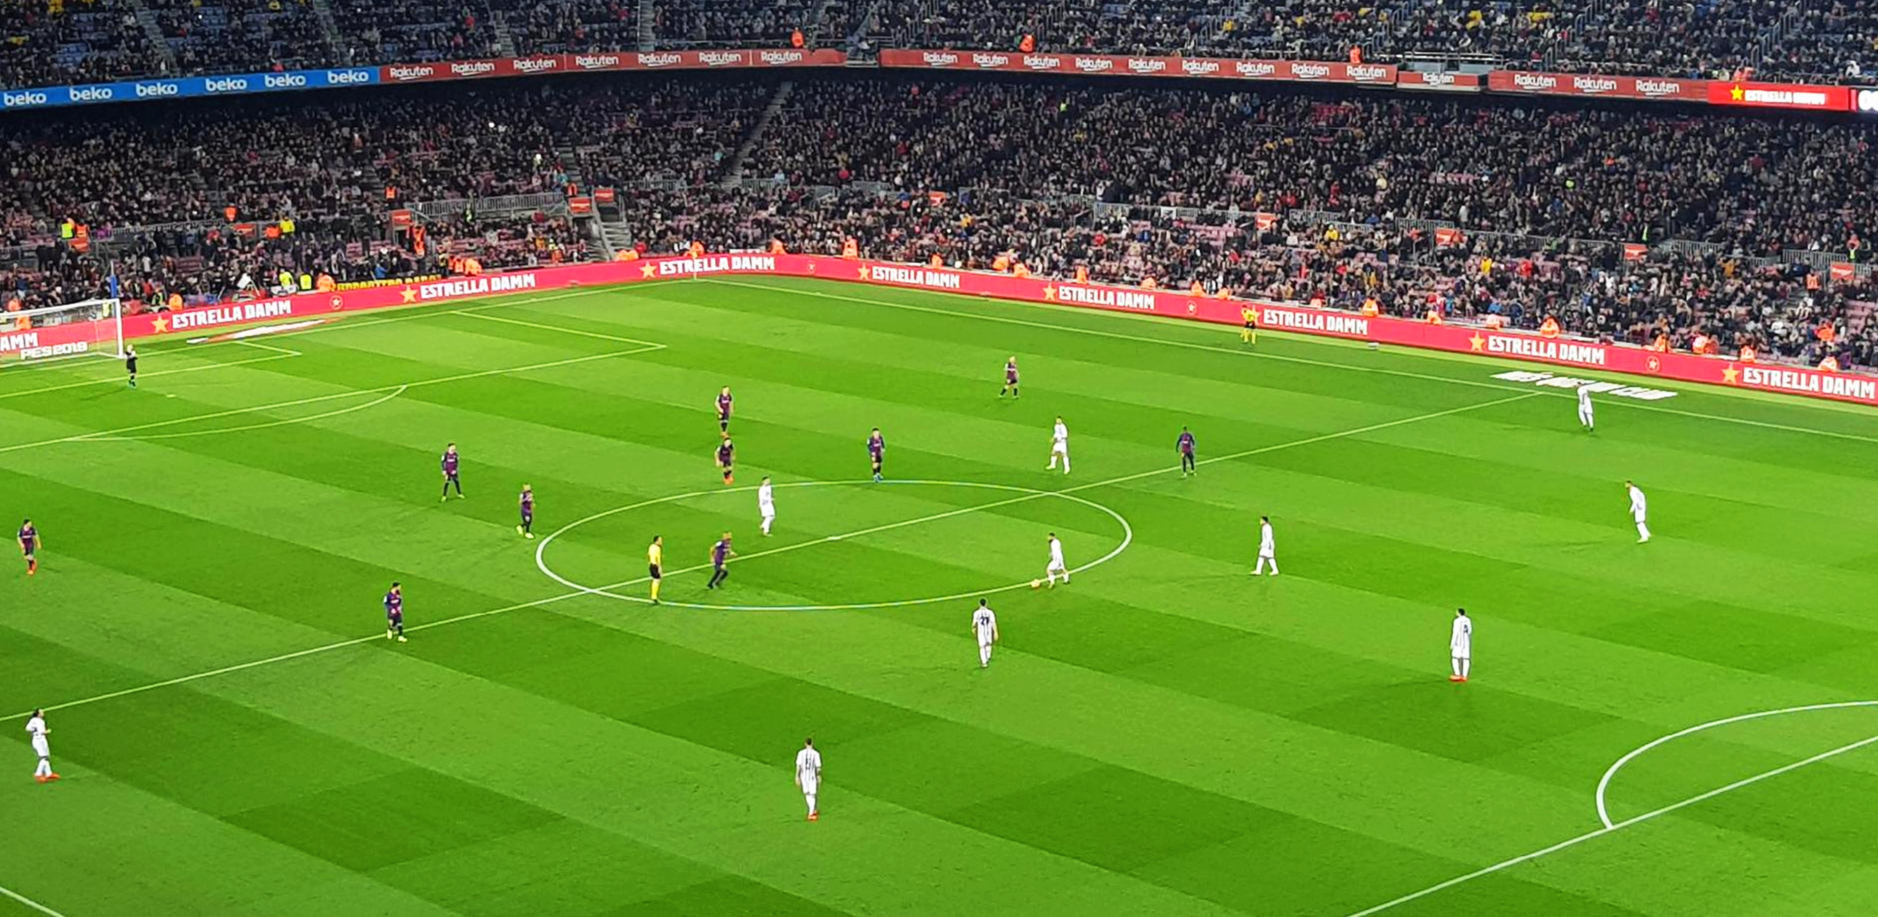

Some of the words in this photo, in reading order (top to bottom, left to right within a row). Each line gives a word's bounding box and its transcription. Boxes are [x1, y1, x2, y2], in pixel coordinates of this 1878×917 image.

[576, 55, 619, 65] Rakuten
[638, 53, 681, 64] Rakuten
[699, 52, 741, 62] Rakuten
[761, 51, 802, 61] Rakuten
[923, 52, 957, 63] Rakuten
[973, 54, 1008, 64] Rakuten
[1024, 56, 1060, 67] Rakuten
[451, 62, 495, 73] Rakuten
[513, 59, 556, 70] Rakuten
[1075, 58, 1112, 68] Rakuten
[1128, 59, 1165, 70] Rakuten
[1182, 60, 1219, 71] Rakuten
[1236, 62, 1274, 73] Rakuten
[390, 66, 433, 78] Rakuten
[1292, 64, 1329, 76] Rakuten
[1347, 65, 1386, 78] Rakuten
[264, 73, 306, 88] beko
[327, 69, 369, 84] beko
[1514, 74, 1556, 87] Rakuten
[205, 76, 248, 92] beko
[1574, 77, 1616, 89] Rakuten
[1636, 80, 1679, 92] Rakuten
[69, 86, 112, 101] beko
[135, 82, 178, 97] beko
[2, 91, 47, 106] beko
[658, 259, 729, 276] ESTRELLA
[730, 254, 775, 272] DAMM
[871, 266, 924, 283] ESTRELLA
[925, 271, 960, 288] DAMM
[420, 279, 489, 299] ESTRELLA
[491, 274, 535, 290] DAMM
[1058, 285, 1115, 305] ESTRELLA
[1116, 291, 1155, 310] DAMM
[172, 308, 243, 329] ESTRELLA
[245, 300, 292, 320] DAMM
[1262, 309, 1325, 332] ESTRELLA
[1326, 315, 1368, 337] DAMM
[1487, 336, 1558, 360] ESTRELLA
[1559, 342, 1605, 365] DAMM
[1742, 366, 1820, 394] ESTRELLA
[1821, 374, 1876, 400] DAMM
